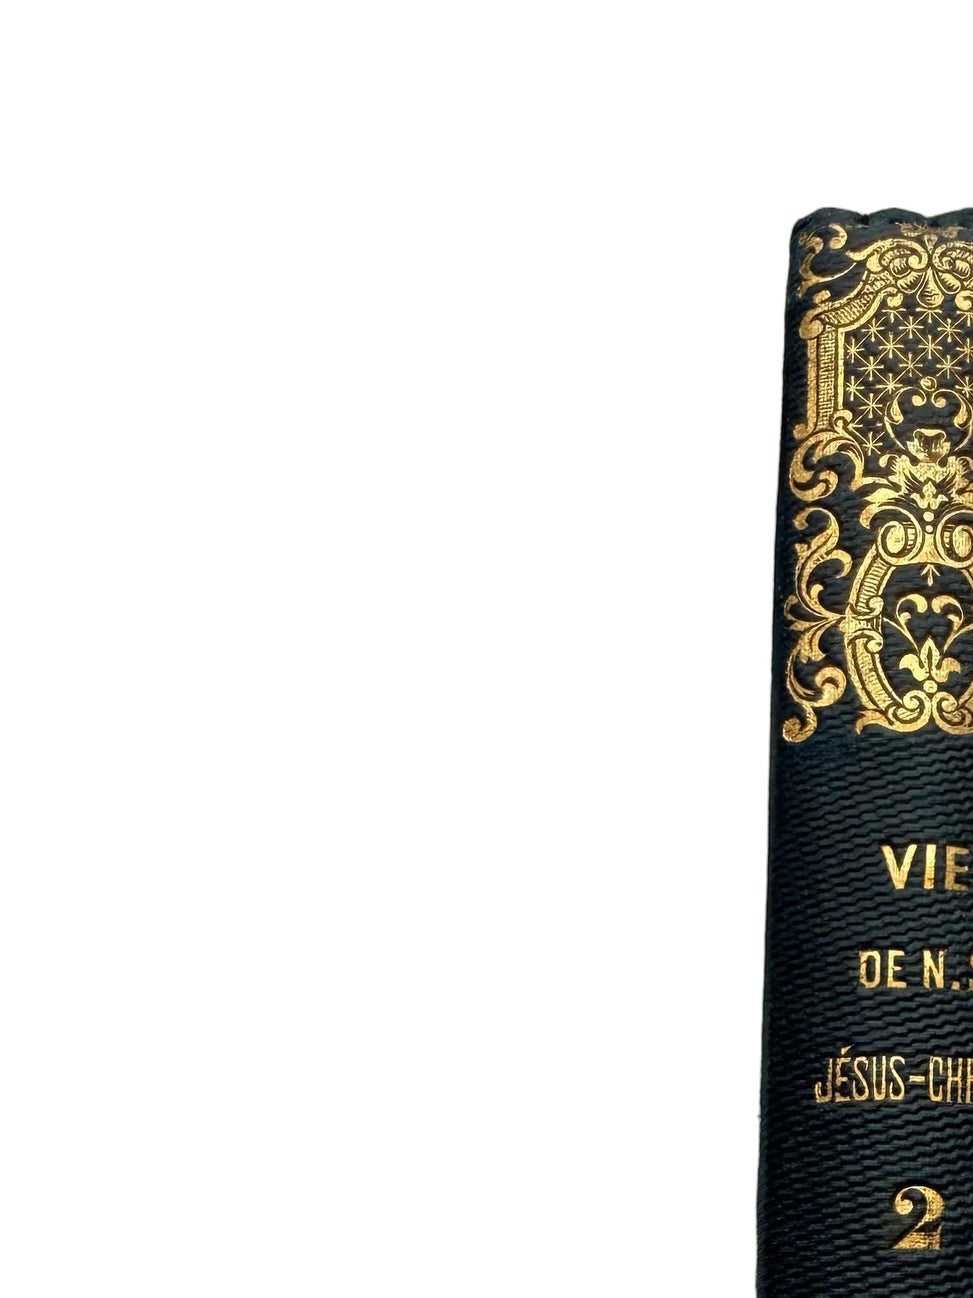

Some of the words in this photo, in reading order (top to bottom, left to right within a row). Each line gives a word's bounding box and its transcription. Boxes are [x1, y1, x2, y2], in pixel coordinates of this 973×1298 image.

[880, 843, 970, 891] VIE
[858, 948, 906, 990] DE
[892, 1185, 945, 1250] 2
